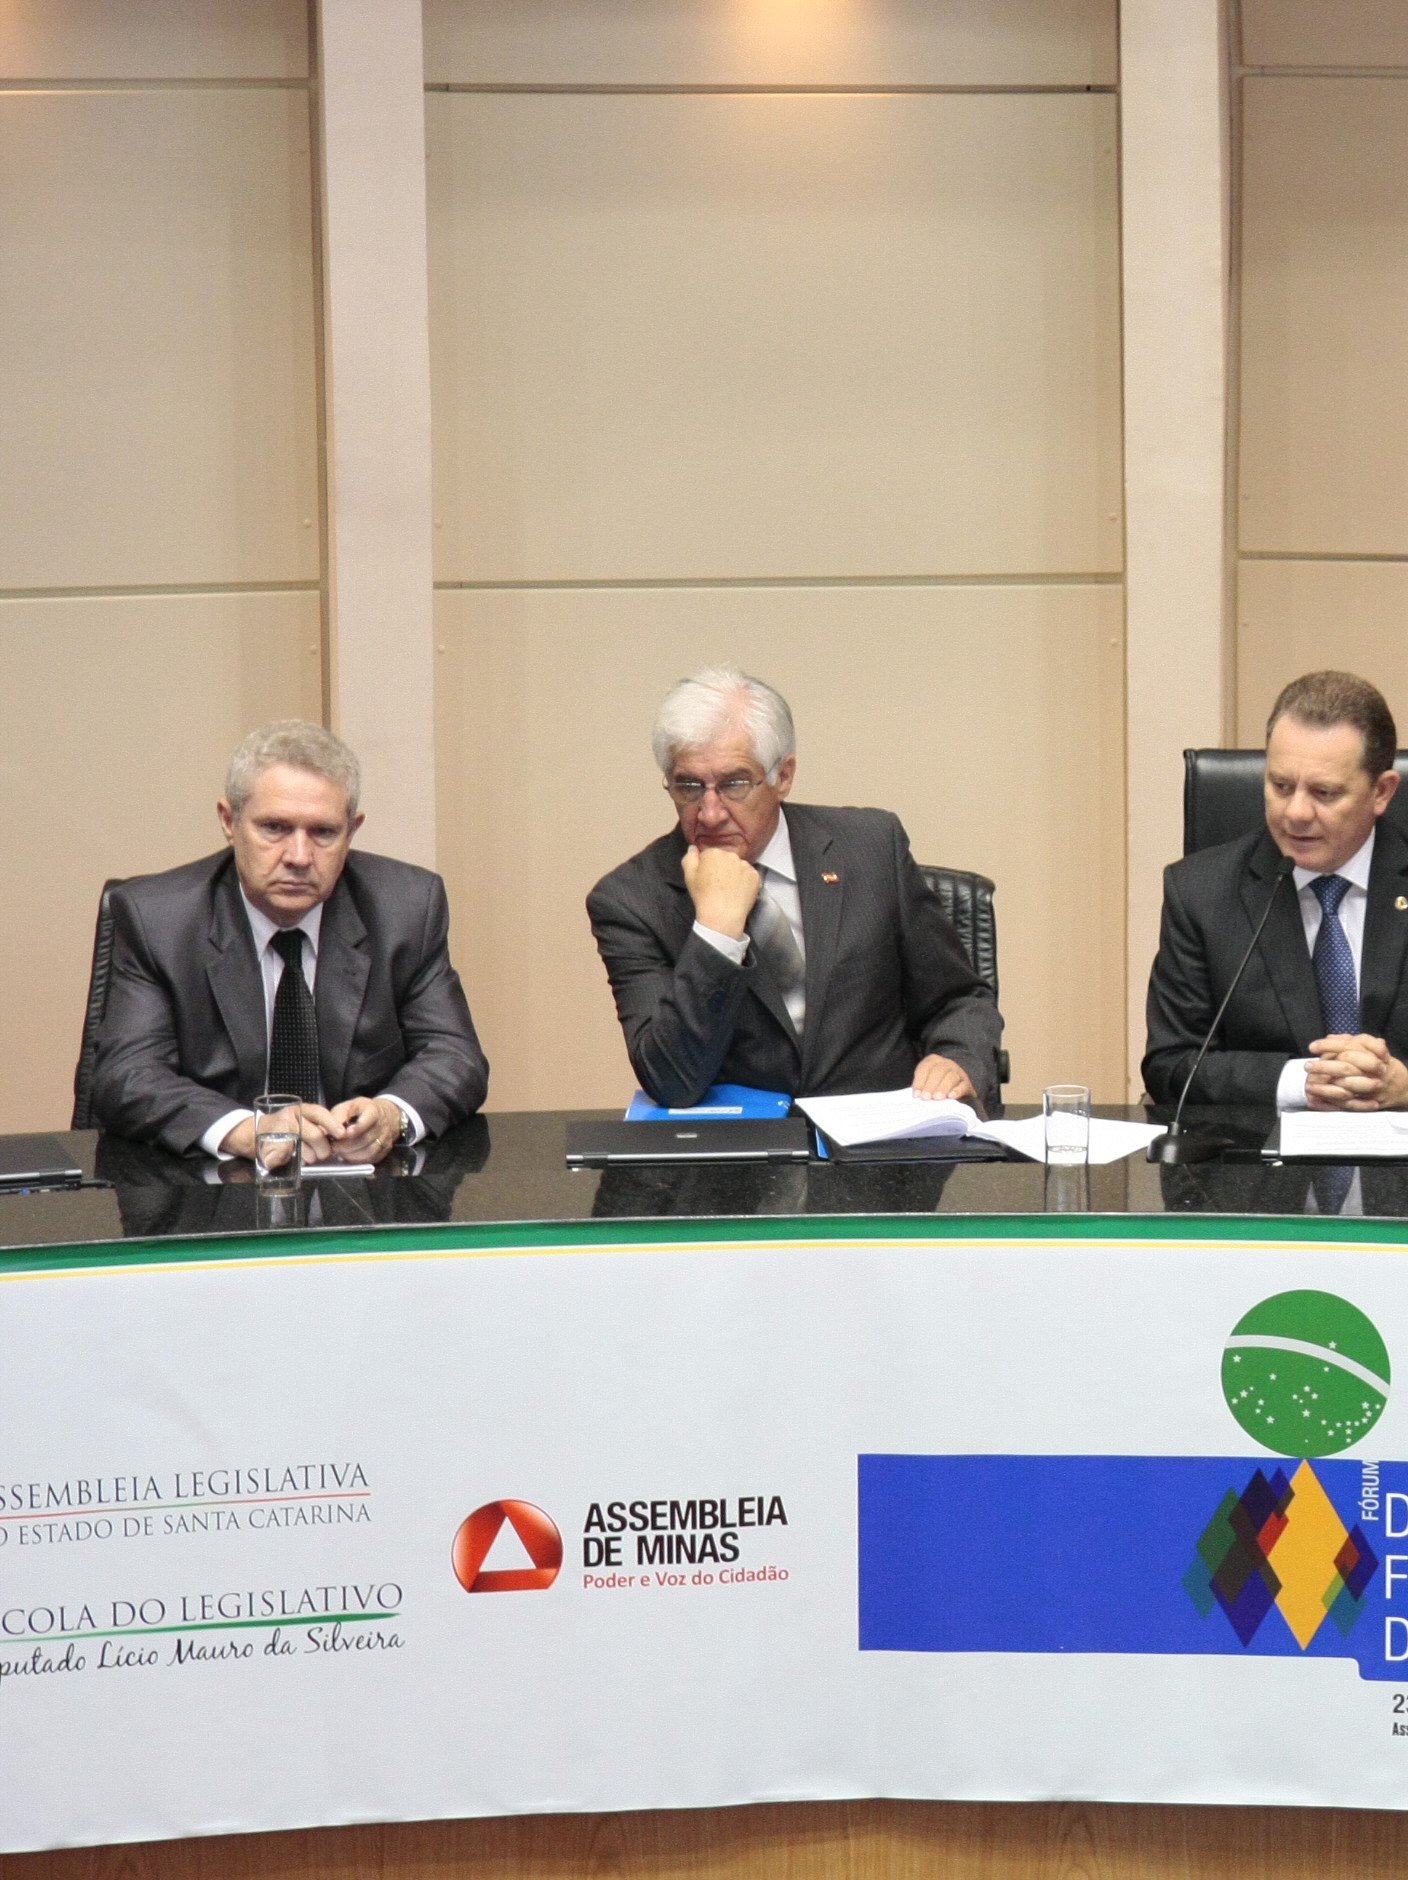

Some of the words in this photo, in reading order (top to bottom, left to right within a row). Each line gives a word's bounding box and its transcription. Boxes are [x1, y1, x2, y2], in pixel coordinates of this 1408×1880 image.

[174, 1462, 370, 1498] LEGISLATIVA
[1357, 1460, 1380, 1521] FÓRUM
[18, 1519, 113, 1546] ESTADO
[123, 1516, 154, 1538] DE
[163, 1509, 240, 1535] SANTA
[248, 1503, 372, 1529] CATARINA
[583, 1496, 788, 1533] ASSEMBLEIA
[583, 1537, 623, 1567] DE
[636, 1532, 740, 1566] MINAS
[583, 1573, 635, 1589] Poder
[640, 1576, 650, 1587] e
[655, 1572, 686, 1586] Voz
[692, 1570, 714, 1585] do
[718, 1566, 790, 1584] Cidadão
[2, 1604, 98, 1635] COLA
[111, 1598, 166, 1627] DO
[180, 1582, 403, 1622] LEGISLATIVO
[97, 1640, 159, 1669] Lício
[166, 1637, 254, 1666] Mauro
[264, 1628, 298, 1656] da
[303, 1621, 406, 1654] Silveira
